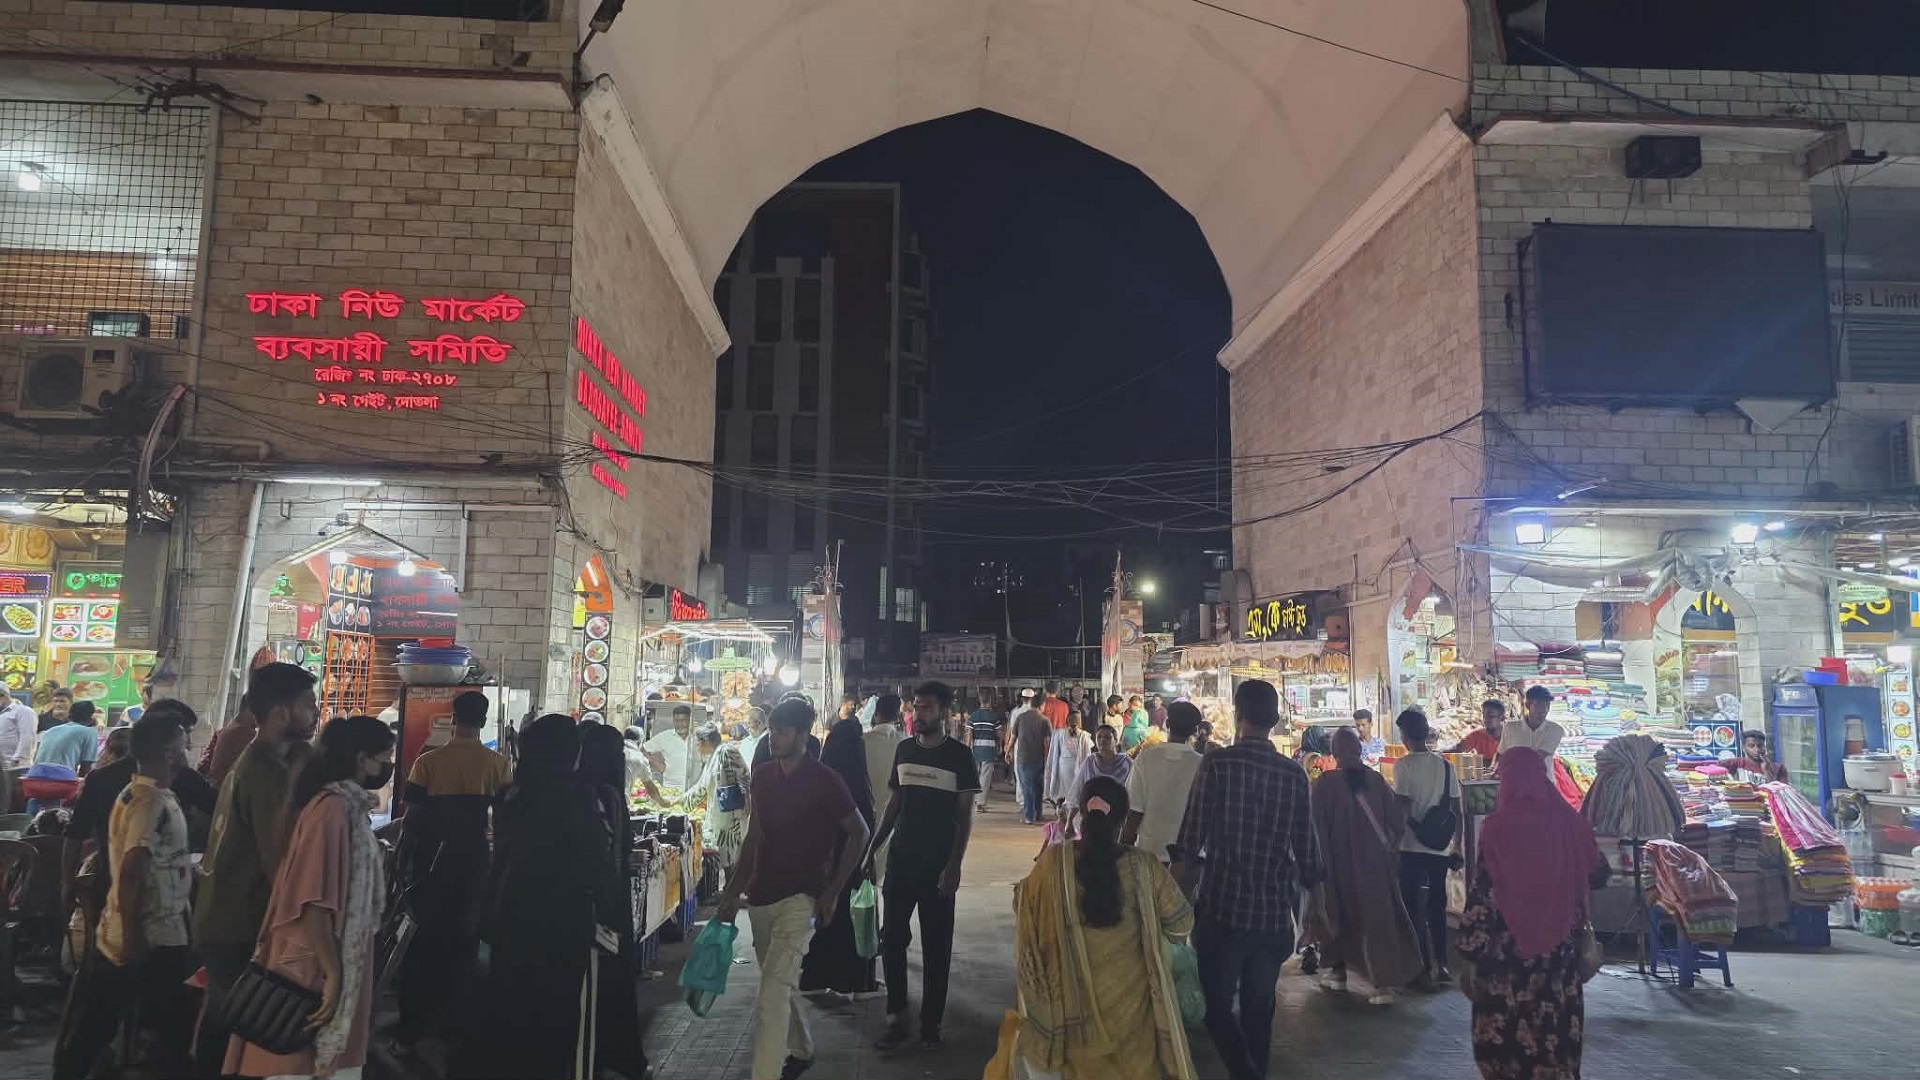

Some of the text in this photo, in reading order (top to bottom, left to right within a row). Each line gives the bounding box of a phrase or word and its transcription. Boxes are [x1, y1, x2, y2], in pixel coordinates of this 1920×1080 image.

[245, 288, 526, 323] ঢাকা নিউ মার্কেট
[253, 331, 513, 364] ব্যবসায়ী সমিতি
[358, 368, 376, 383] নং
[577, 315, 647, 419] DHAKA NEW MARKET
[317, 391, 326, 405] ১
[329, 392, 348, 407] নং
